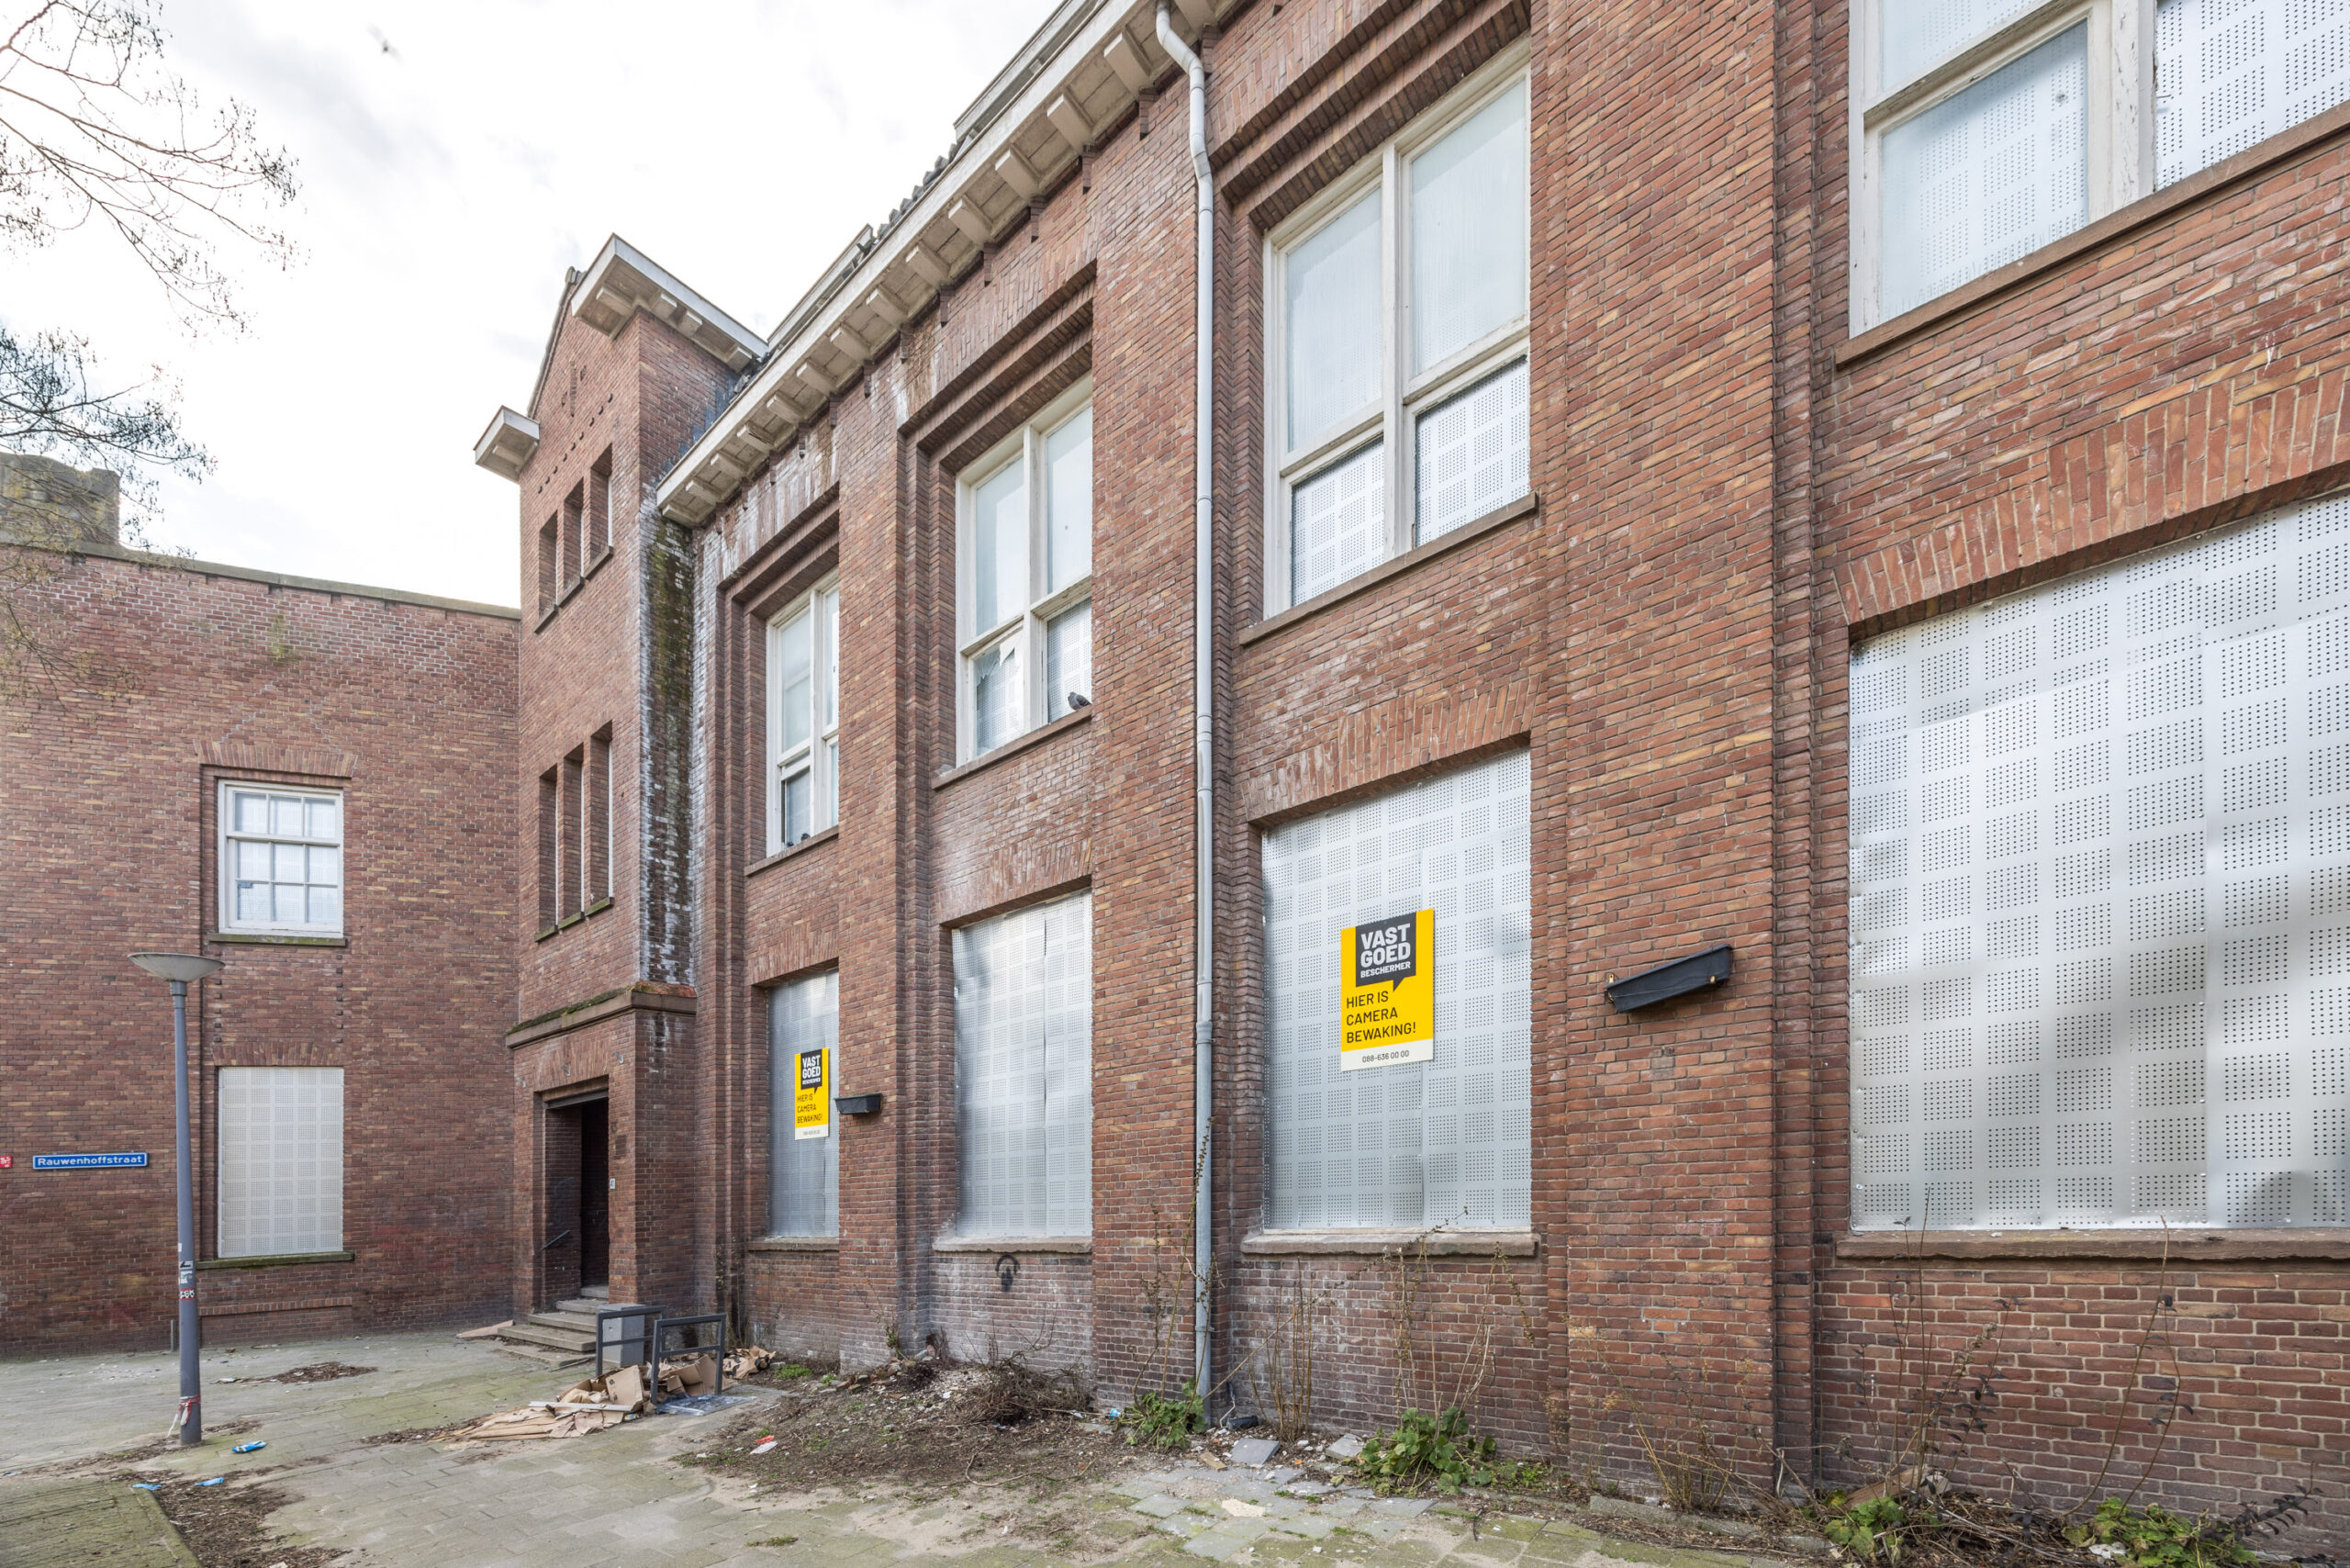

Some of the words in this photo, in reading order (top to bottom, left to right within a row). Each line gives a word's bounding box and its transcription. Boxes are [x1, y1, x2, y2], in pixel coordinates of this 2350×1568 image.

[1360, 923, 1411, 950] VAST
[1360, 942, 1411, 968] GOED
[1360, 961, 1411, 979] BESCHERMER
[1347, 993, 1374, 1009] HIER
[1377, 991, 1389, 1003] IS
[1346, 1007, 1398, 1026] CAMERA
[1347, 1022, 1416, 1044] BEWAKING!
[802, 1055, 822, 1069] VAST
[1362, 1052, 1390, 1063] 088-636
[1390, 1051, 1399, 1059] 00
[1400, 1049, 1410, 1058] 00
[802, 1066, 822, 1079] GOED
[797, 1103, 817, 1114] CAMERA
[38, 1155, 142, 1167] Rauwenhoffstraat
